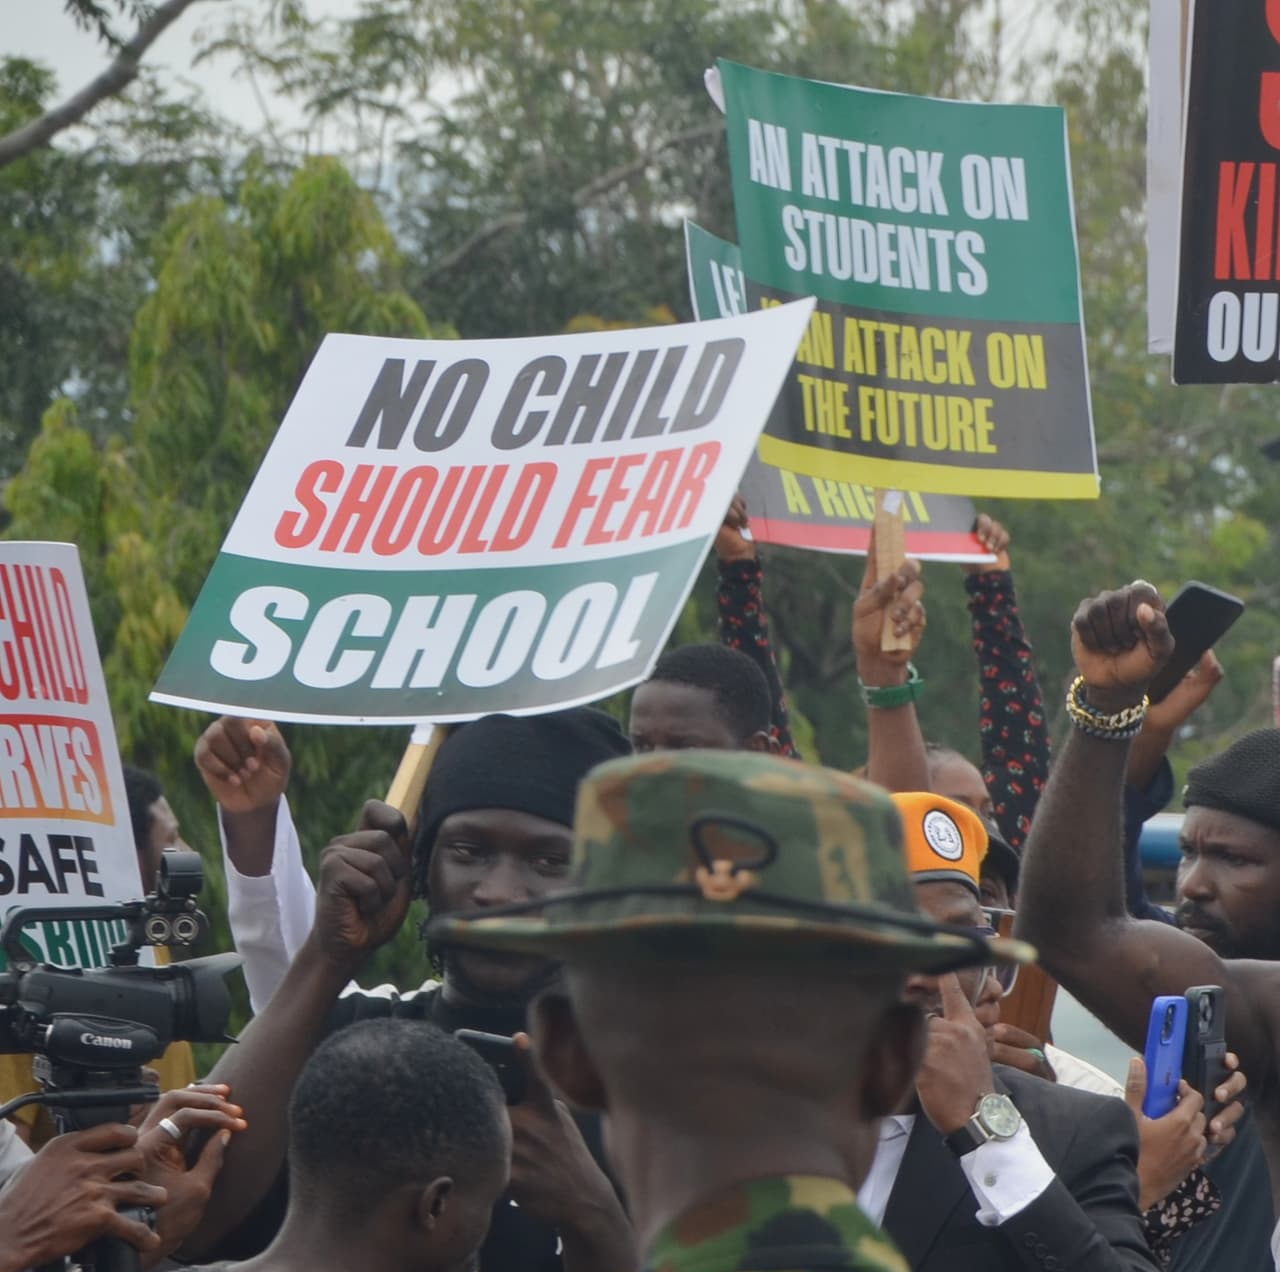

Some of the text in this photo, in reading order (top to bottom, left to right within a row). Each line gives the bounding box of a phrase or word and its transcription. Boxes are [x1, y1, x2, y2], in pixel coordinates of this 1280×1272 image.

[748, 118, 1029, 221] AN ATTACK ON
[782, 204, 989, 296] STUDENTS
[345, 337, 747, 453] NO CHILD
[796, 312, 1048, 390] AN ATTACK ON
[797, 373, 998, 454] THE FUTURE
[273, 440, 722, 557] SHOULD FEAR
[811, 476, 931, 523] RIGT
[209, 572, 660, 690] SCHOOL
[0, 723, 104, 816] RVES
[80, 1033, 132, 1049] Canon
